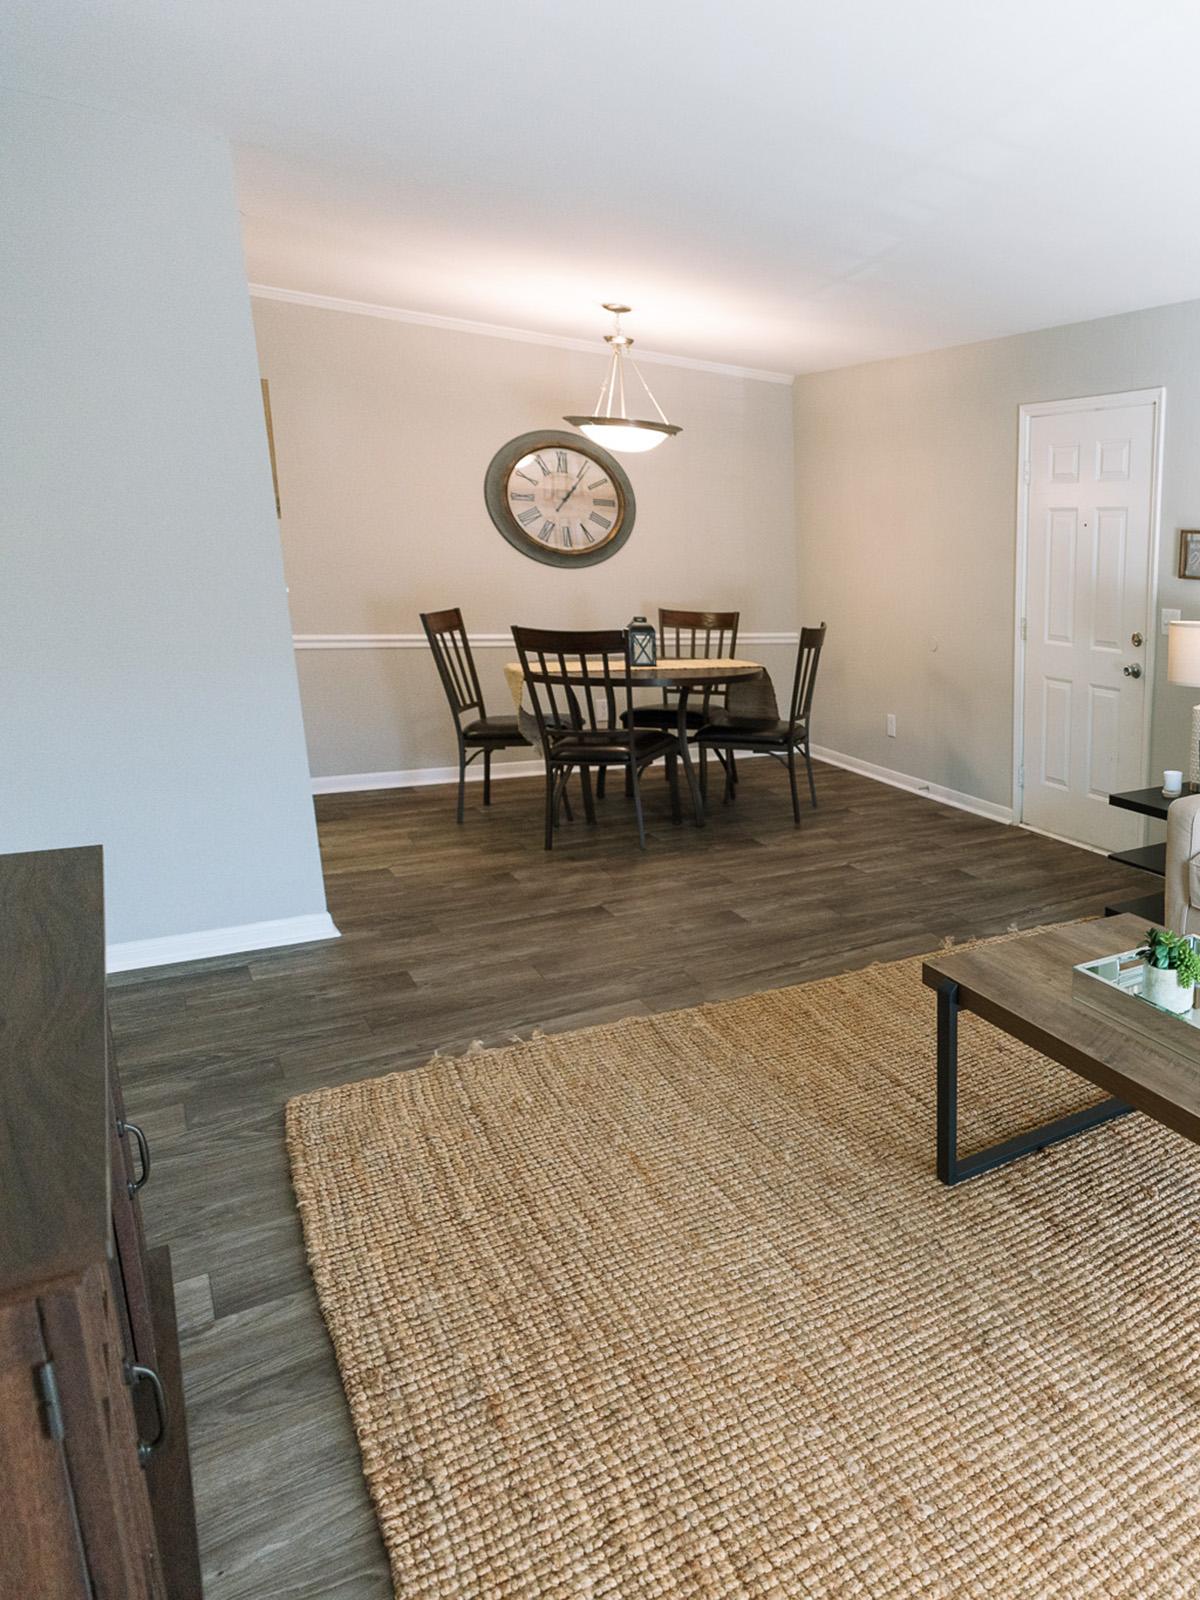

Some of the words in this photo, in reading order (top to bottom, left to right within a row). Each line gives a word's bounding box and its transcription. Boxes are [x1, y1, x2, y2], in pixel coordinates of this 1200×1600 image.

[535, 454, 551, 477] XI
[556, 451, 568, 474] XII
[576, 460, 588, 479] I
[515, 470, 539, 487] X
[587, 478, 608, 491] II
[510, 492, 535, 502] IX
[517, 505, 542, 527] VIII
[537, 519, 555, 543] VII
[561, 526, 573, 548] VI
[579, 522, 596, 543] V
